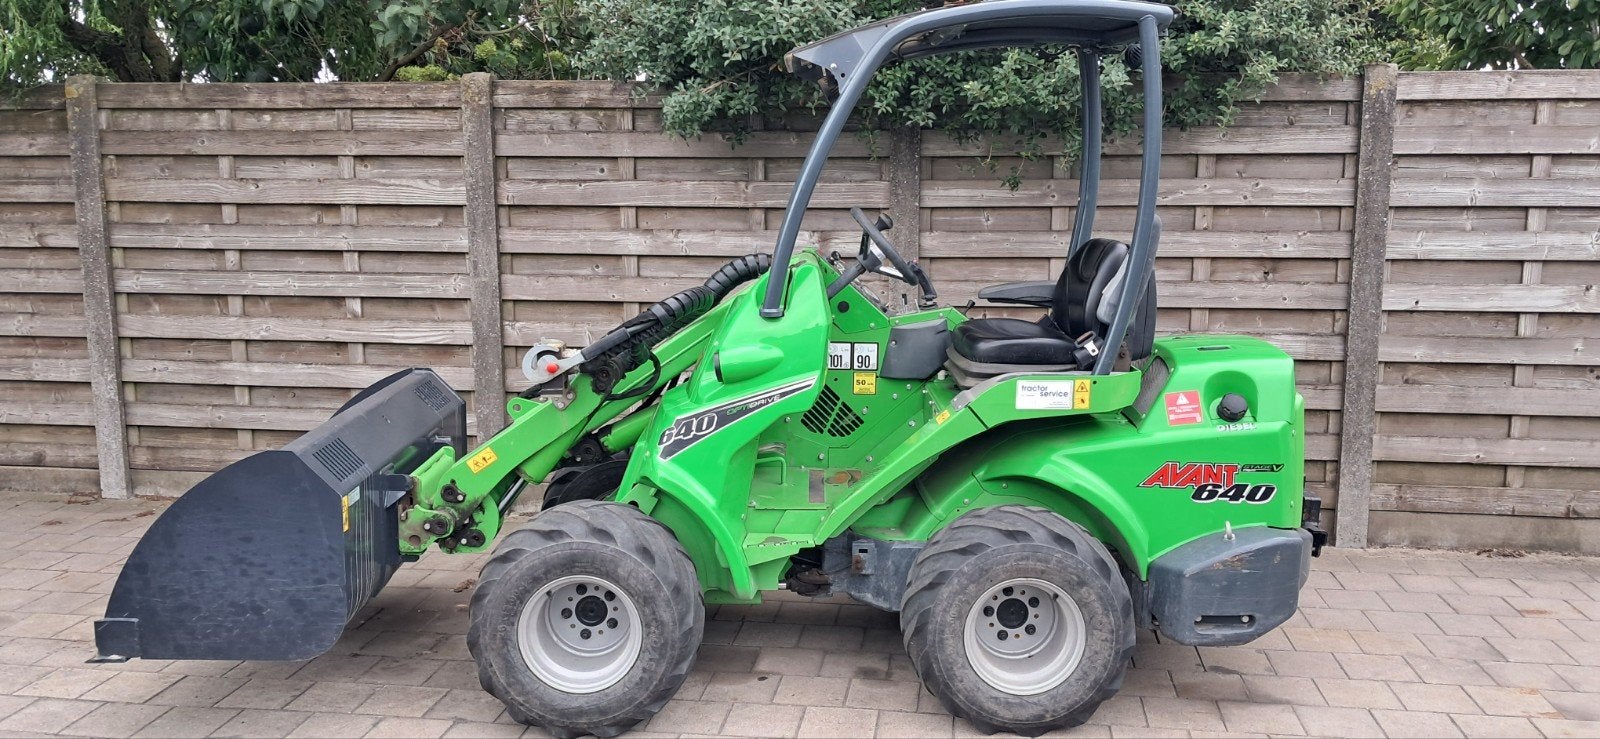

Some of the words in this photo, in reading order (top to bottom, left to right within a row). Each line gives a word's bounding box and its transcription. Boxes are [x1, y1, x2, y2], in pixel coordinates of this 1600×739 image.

[857, 354, 871, 369] 90
[1021, 384, 1048, 392] tractor
[726, 394, 782, 416] OPTIDRIVE
[657, 412, 718, 447] 640
[1217, 422, 1257, 432] DIESEL
[1139, 462, 1239, 488] AVANT
[1272, 464, 1284, 472] V
[1191, 483, 1277, 504] 640
